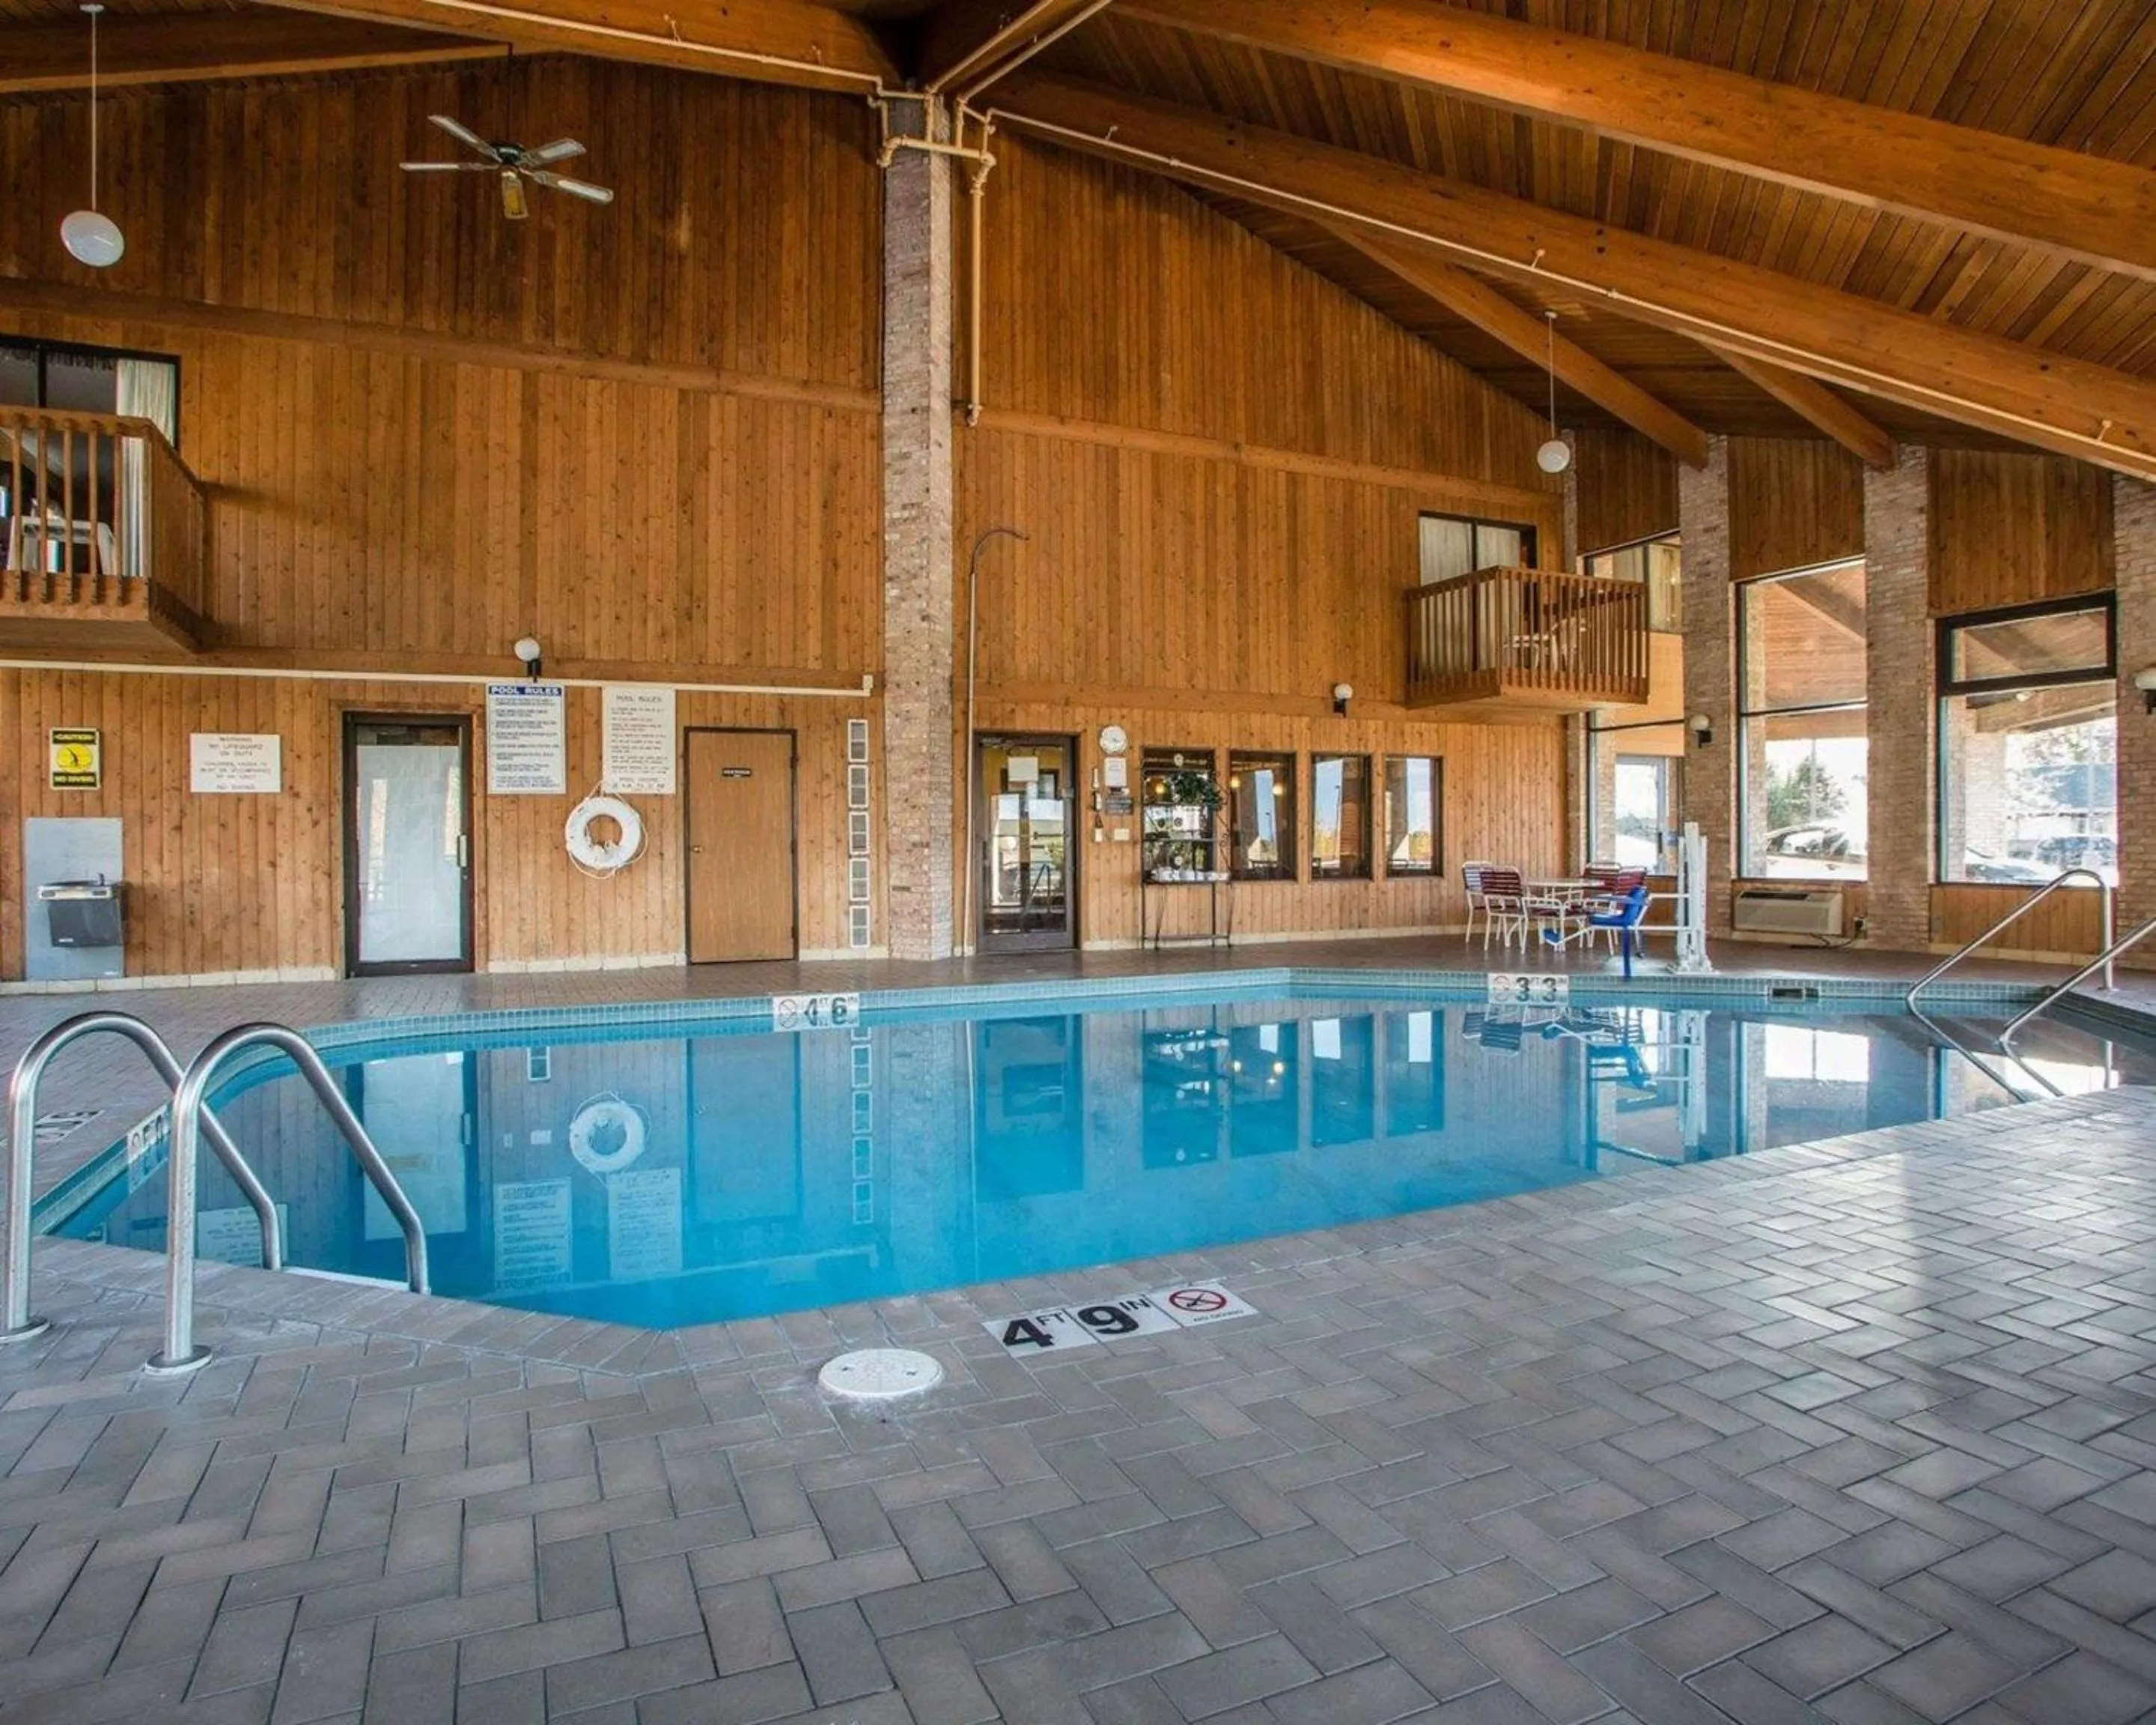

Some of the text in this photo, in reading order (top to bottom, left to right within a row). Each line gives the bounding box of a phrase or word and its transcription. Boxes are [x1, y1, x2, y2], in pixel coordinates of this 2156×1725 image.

[491, 686, 559, 696] POOL RULES
[1002, 1298, 1151, 1348] 4 FT 9 IN
